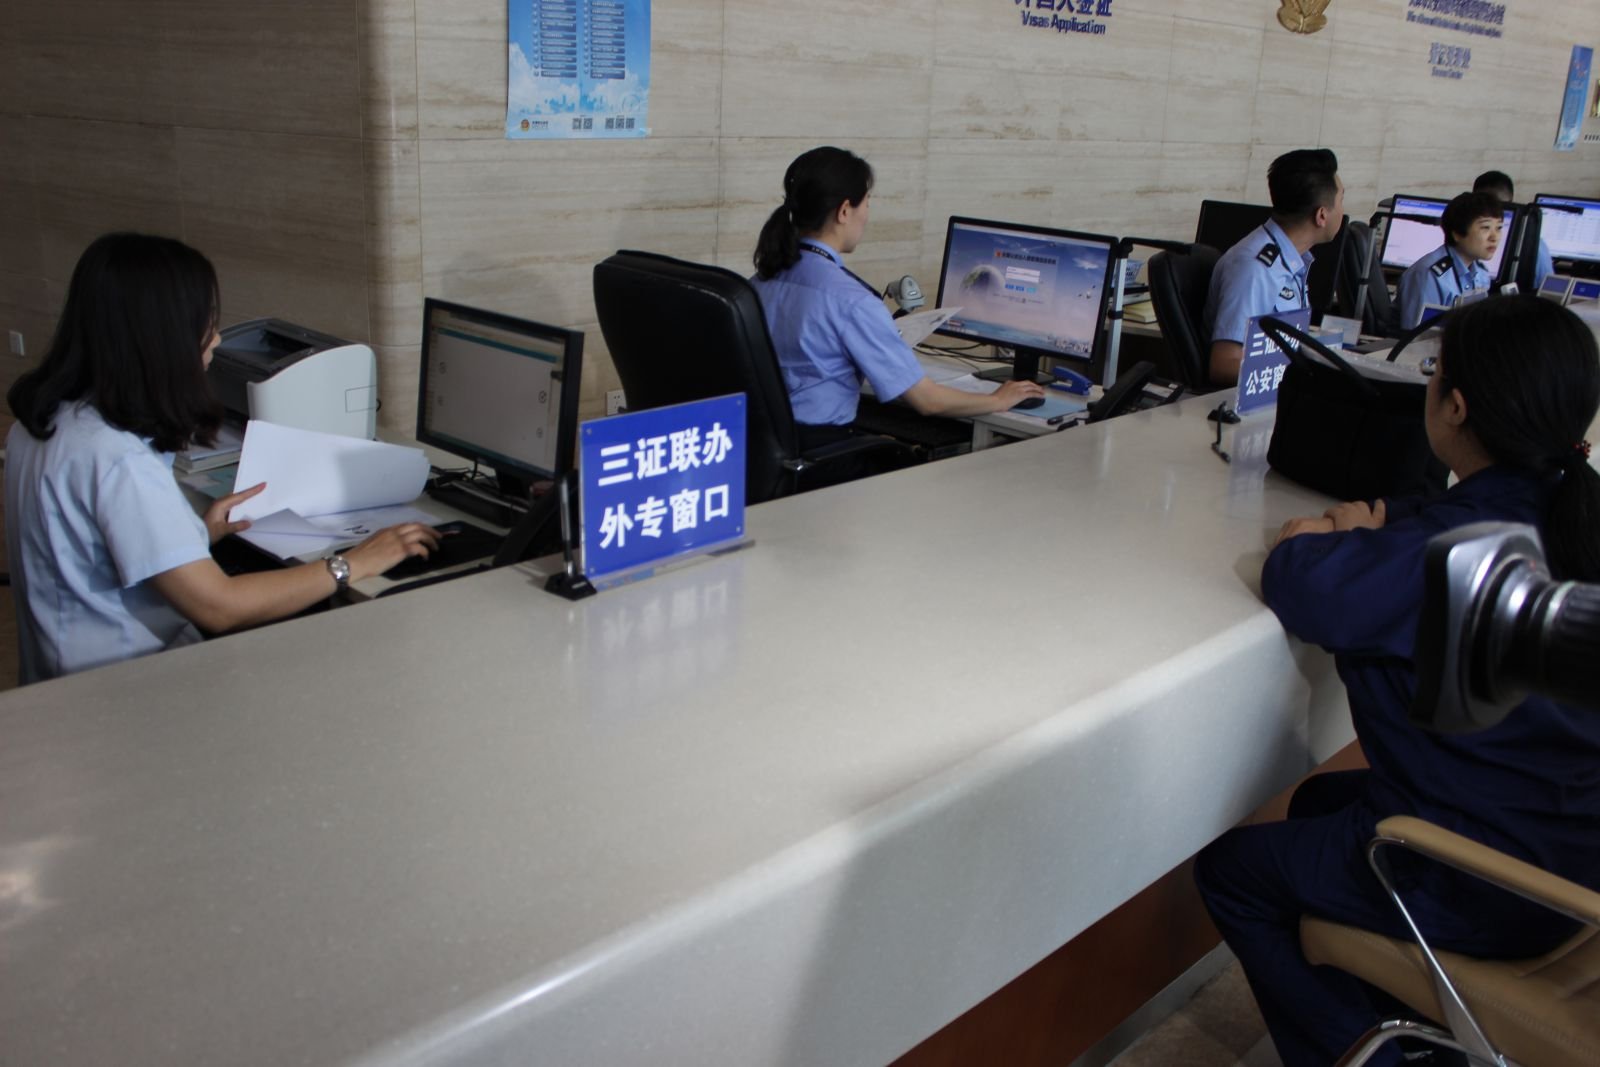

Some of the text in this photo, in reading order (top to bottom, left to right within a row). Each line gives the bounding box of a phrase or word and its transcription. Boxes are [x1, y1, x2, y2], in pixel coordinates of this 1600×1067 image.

[1021, 10, 1106, 35] Visas Application
[598, 421, 733, 487] 三证联办
[599, 483, 730, 549] 外专窗口
